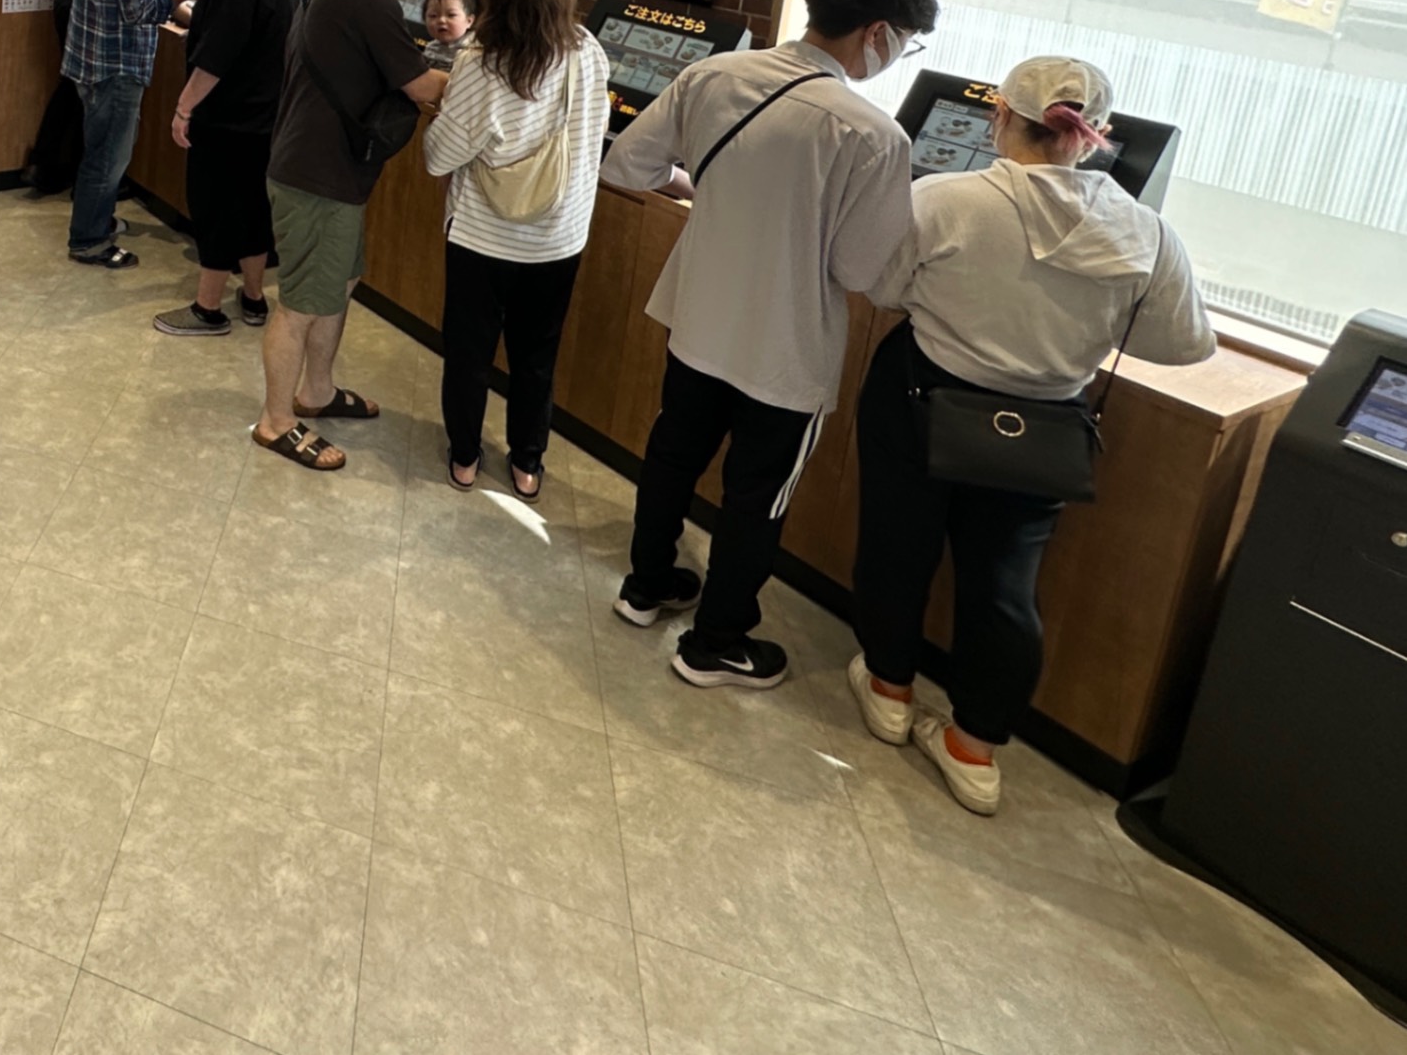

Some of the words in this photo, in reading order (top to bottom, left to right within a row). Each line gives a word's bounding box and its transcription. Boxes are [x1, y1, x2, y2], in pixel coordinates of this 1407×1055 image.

[623, 4, 706, 33] ご注文はこちら
